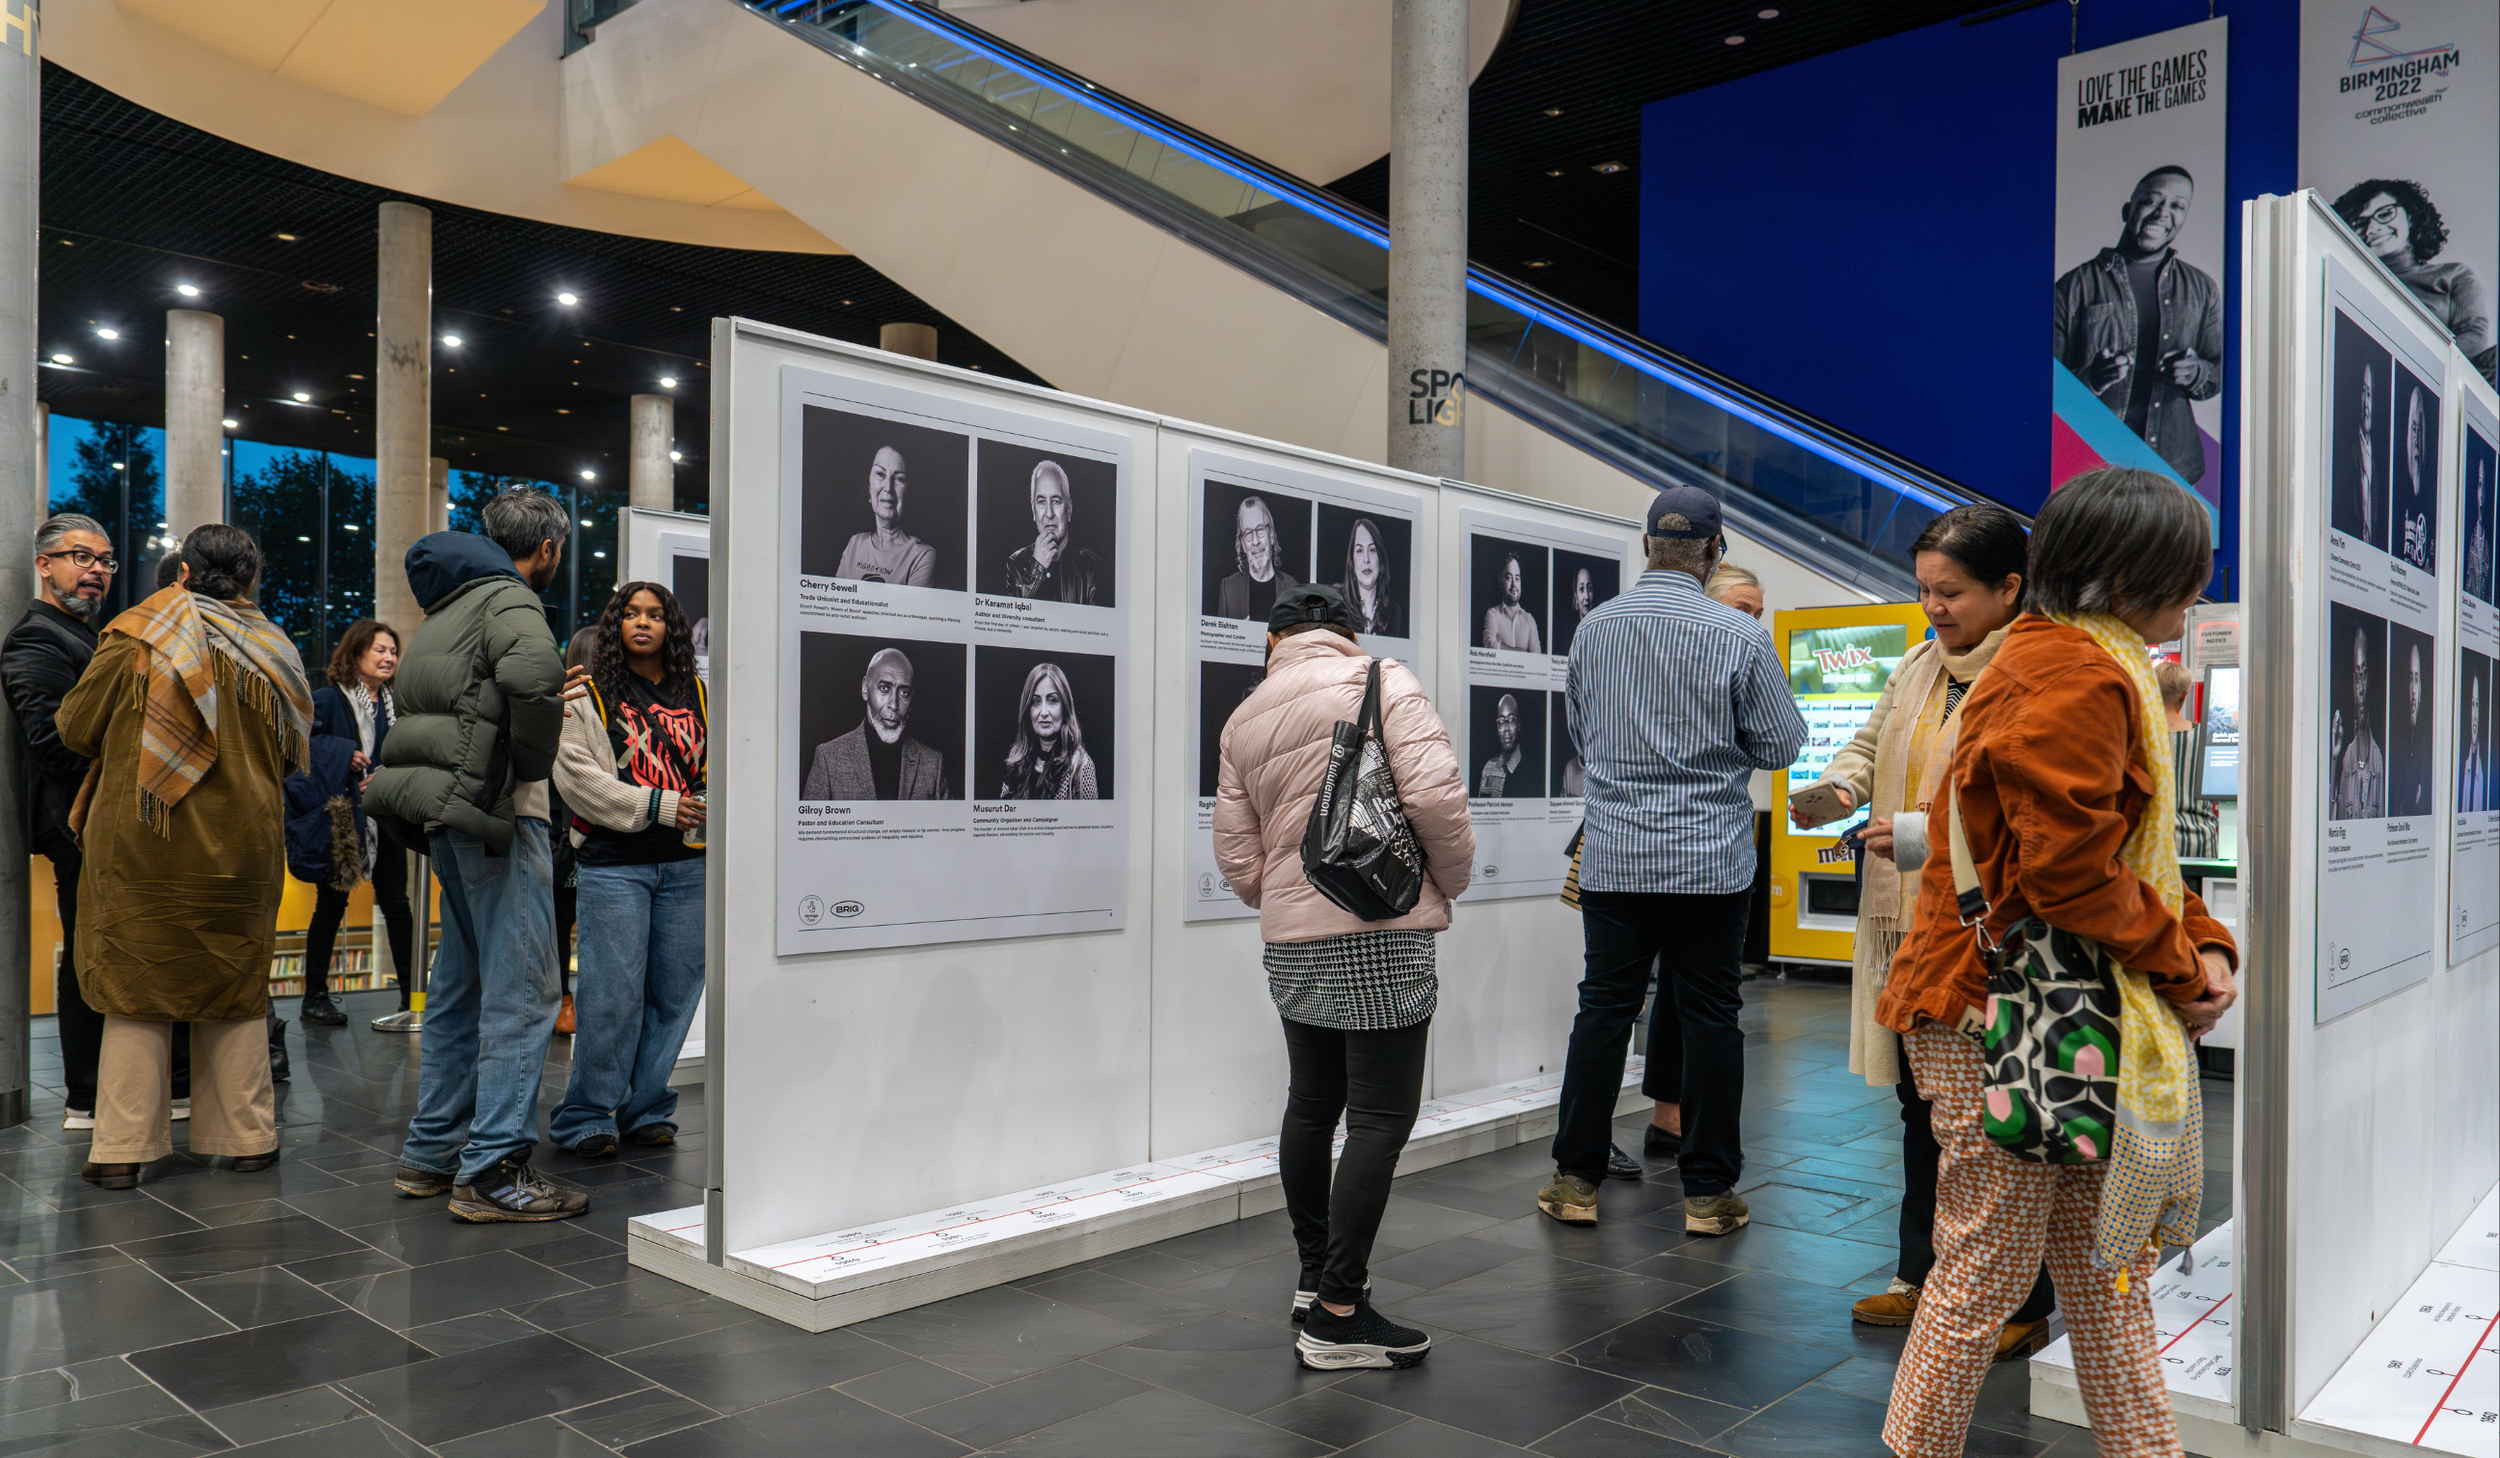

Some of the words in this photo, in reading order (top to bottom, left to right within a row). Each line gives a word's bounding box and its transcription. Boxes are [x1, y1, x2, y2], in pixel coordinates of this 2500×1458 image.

[2078, 71, 2114, 107] LOVE
[2118, 65, 2148, 97] THE
[2151, 49, 2207, 90] GAMES
[2340, 50, 2460, 94] BIRMINGHAM
[2374, 77, 2421, 102] 2022
[2078, 97, 2132, 129] MAKE
[2136, 91, 2162, 117] THE
[2164, 79, 2206, 110] GAMES
[2355, 93, 2442, 120] commonwealth
[2370, 105, 2427, 125] collective
[800, 579, 829, 592] Cherry
[831, 582, 858, 593] Sewell
[852, 599, 888, 608] Educationalist
[975, 598, 983, 606] Dr
[985, 599, 1013, 609] Karamat
[1015, 602, 1032, 612] Iqbal
[1201, 619, 1217, 628] Derek
[1218, 620, 1238, 630] Bishton
[1814, 644, 1874, 671] Twix
[1319, 761, 1341, 816] lululemon
[798, 805, 823, 816] Gilroy
[825, 806, 851, 814] Brown
[973, 804, 1003, 812] Musurut
[1004, 804, 1017, 812] Dar
[836, 905, 859, 913] BRIG
